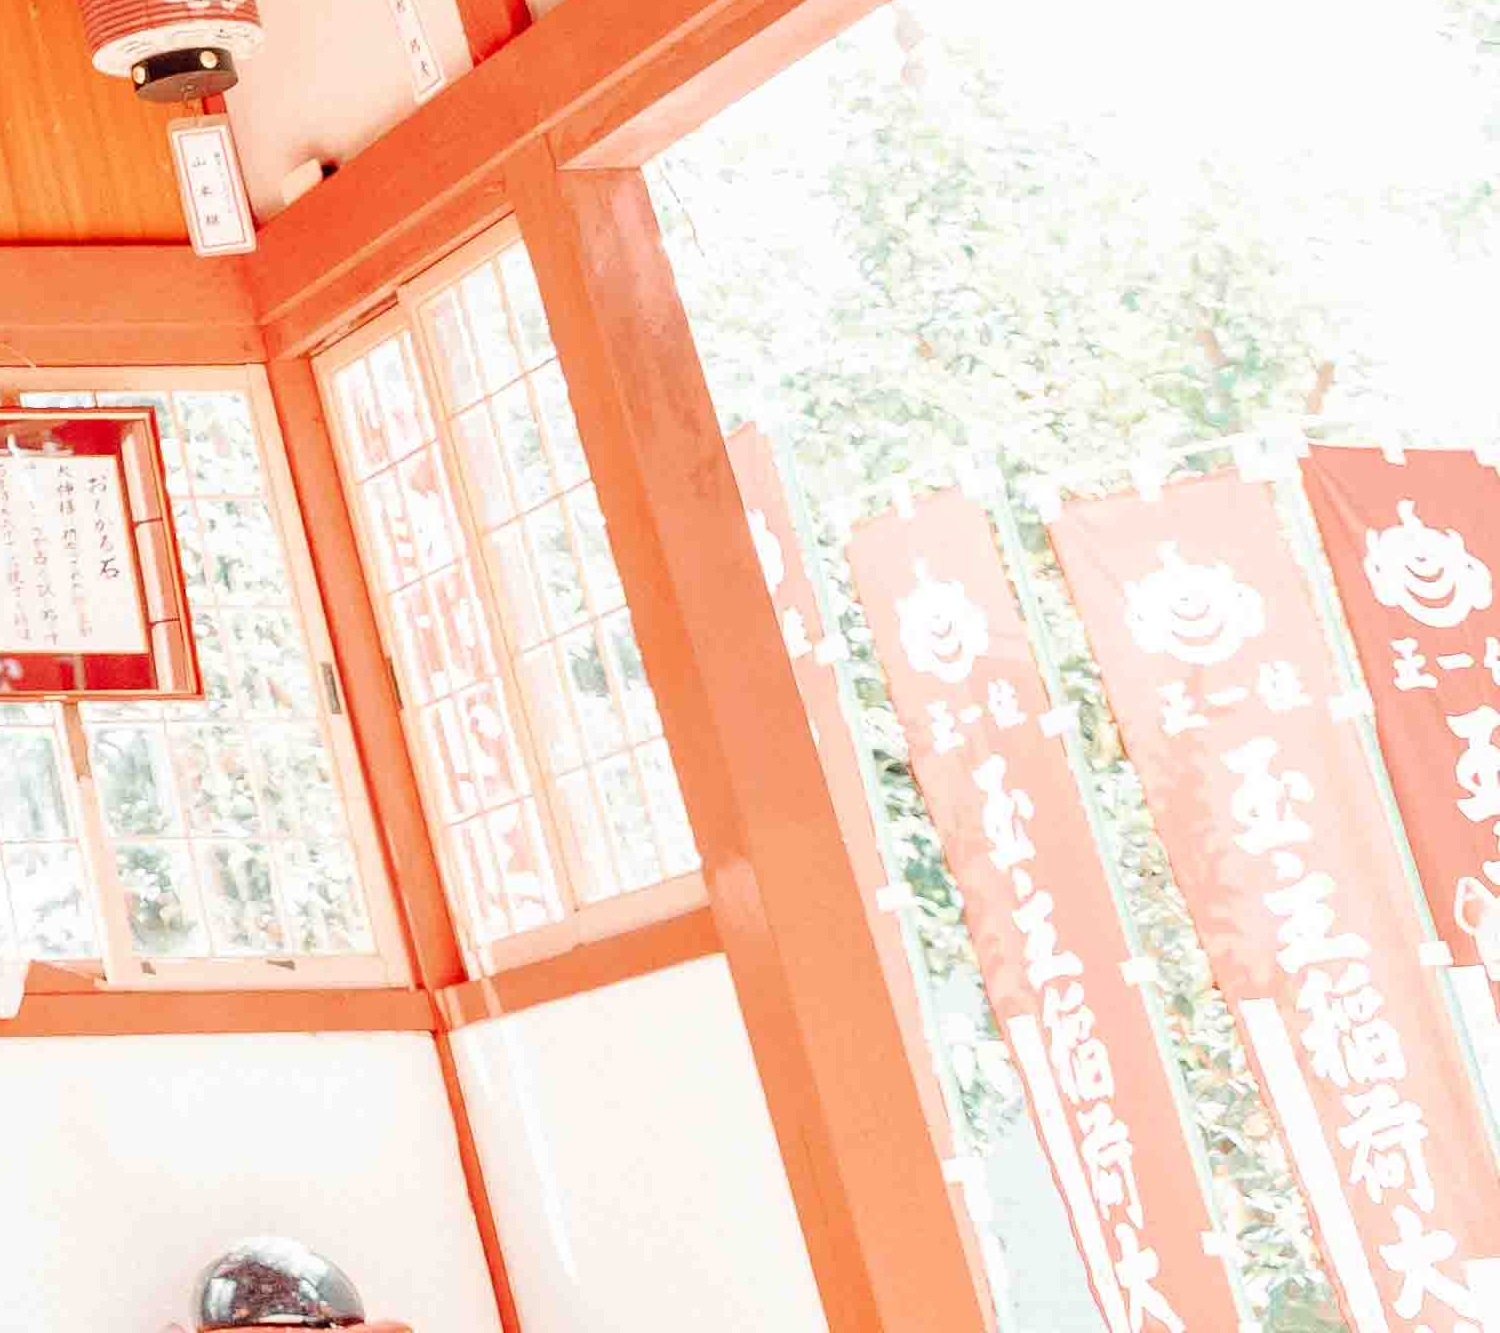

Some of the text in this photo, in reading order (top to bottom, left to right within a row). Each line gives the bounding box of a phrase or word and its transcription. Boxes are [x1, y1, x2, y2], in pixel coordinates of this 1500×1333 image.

[1390, 636, 1500, 696] 正一
[1220, 737, 1482, 1333] 玉主稲荷大
